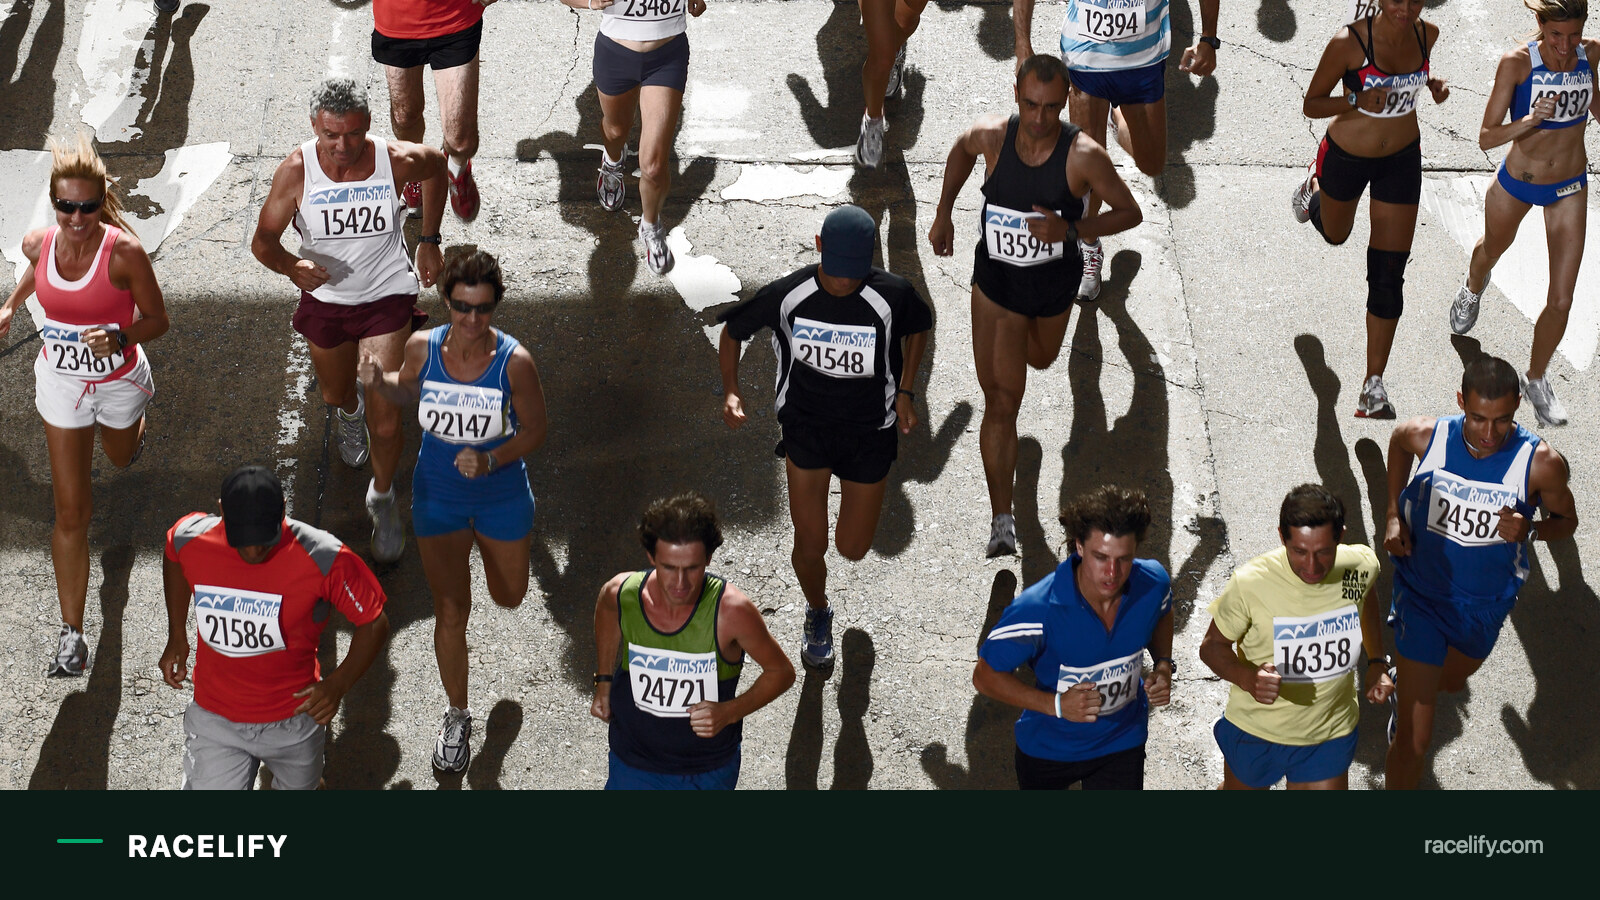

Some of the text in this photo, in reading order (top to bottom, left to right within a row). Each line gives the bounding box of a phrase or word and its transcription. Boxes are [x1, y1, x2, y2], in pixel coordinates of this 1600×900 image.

[1085, 9, 1138, 38] 12394
[347, 185, 391, 203] RunStyle
[321, 205, 386, 236] 15426
[993, 229, 1054, 259] 13594
[830, 330, 876, 349] RunStyle
[800, 343, 865, 374] 21548
[456, 391, 502, 411] RunStyle
[426, 409, 492, 438] 22147
[1467, 487, 1517, 508] RunStyle
[1435, 497, 1501, 539] 24587
[1342, 568, 1359, 583] BA
[233, 595, 280, 618] RunStyle
[205, 614, 275, 649] 21586
[1316, 612, 1360, 637] RunStyle
[667, 656, 718, 674] RunStyle
[1280, 637, 1351, 676] 16358
[638, 672, 706, 708] 24721
